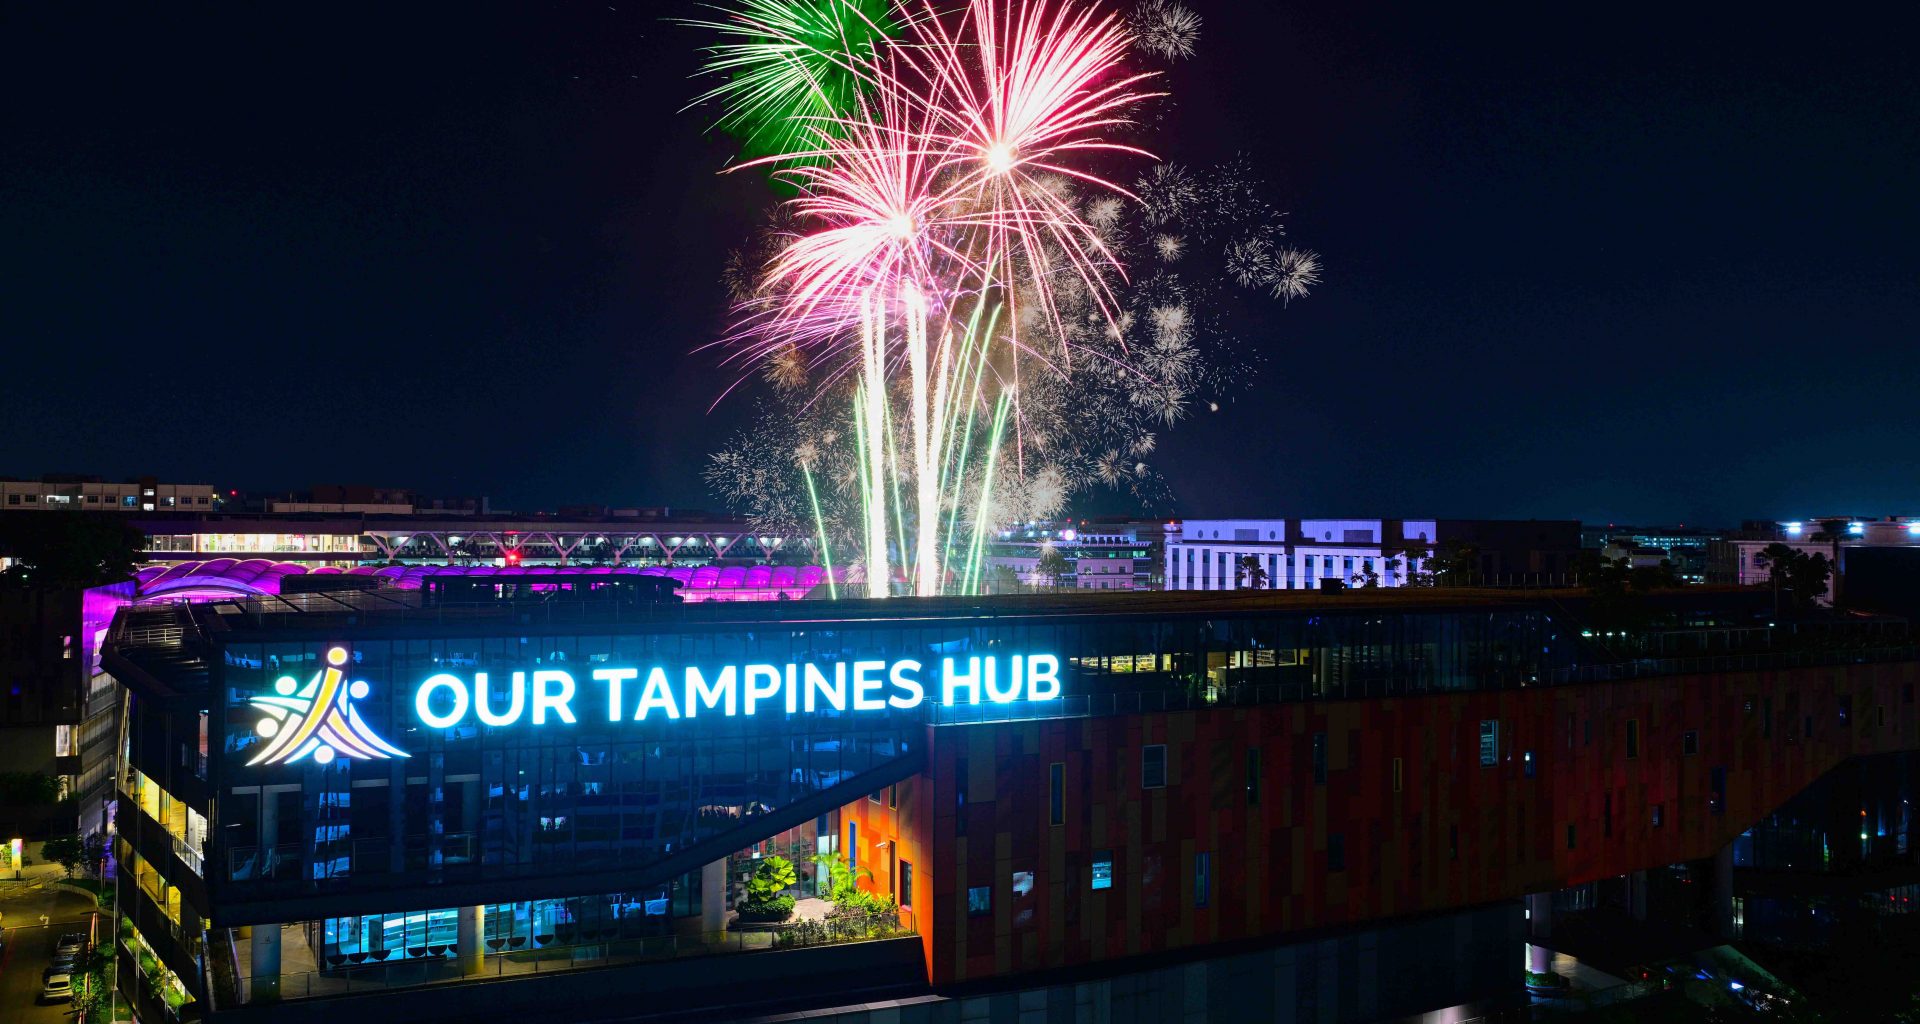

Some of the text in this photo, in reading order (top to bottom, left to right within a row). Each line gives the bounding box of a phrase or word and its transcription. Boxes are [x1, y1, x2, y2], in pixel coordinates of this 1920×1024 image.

[415, 655, 1061, 729] OUR TAMPINES HUB
